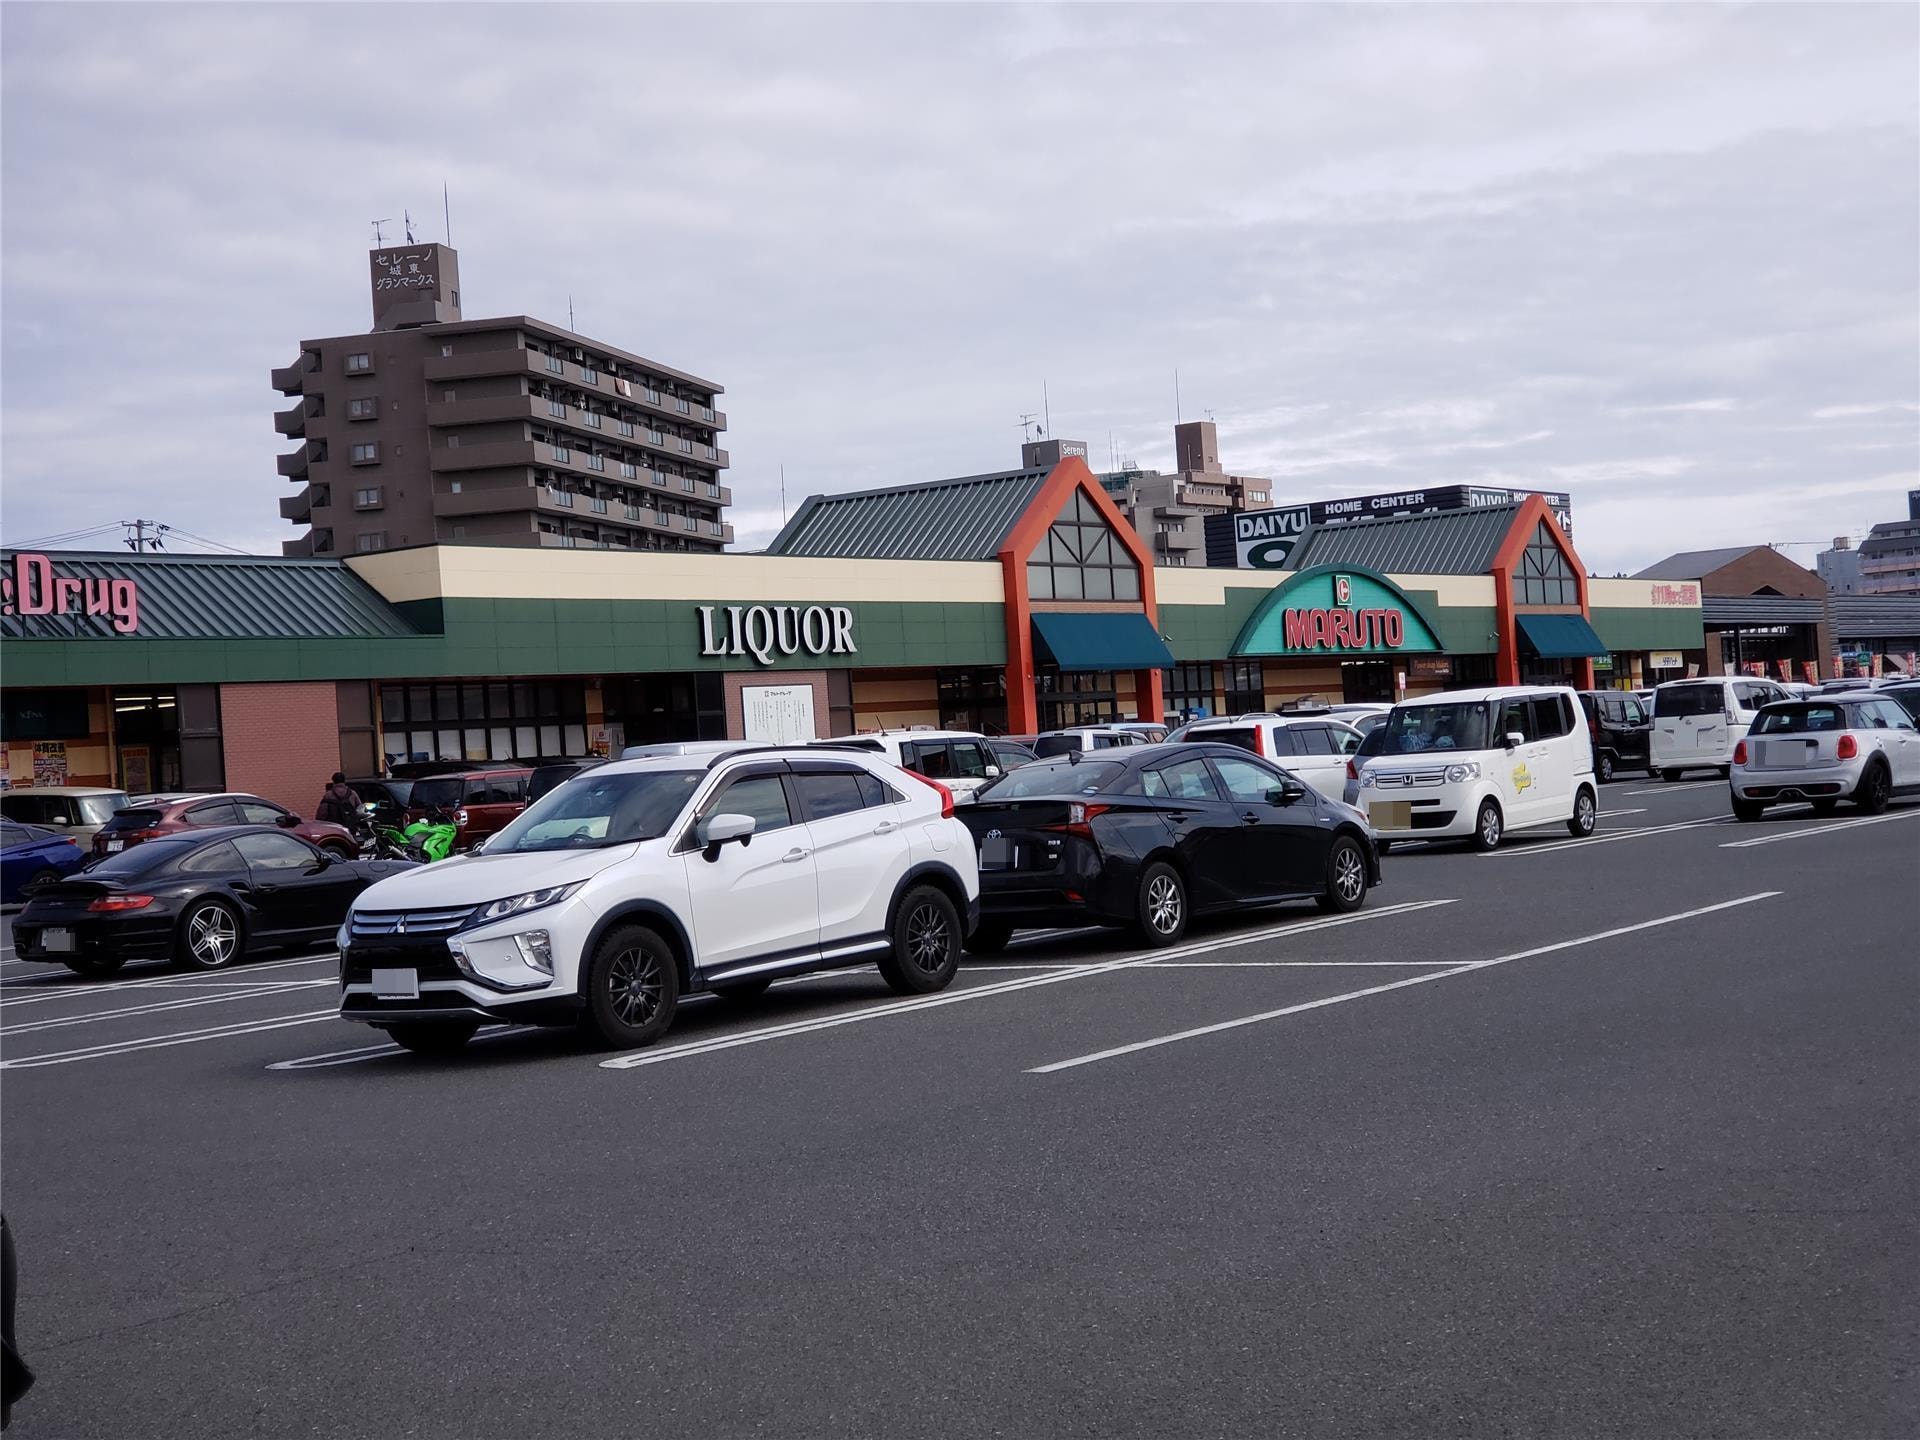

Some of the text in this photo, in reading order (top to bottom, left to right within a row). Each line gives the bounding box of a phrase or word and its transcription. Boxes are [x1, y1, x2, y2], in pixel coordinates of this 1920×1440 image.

[376, 249, 432, 265] セレーノ
[390, 263, 420, 275] 城東
[377, 274, 434, 290] グランマークス
[1062, 443, 1085, 456] Sereno
[1325, 493, 1425, 515] HOME CENTER
[1239, 512, 1307, 539] DAIYU
[699, 605, 858, 665] LIQUOR
[1285, 607, 1405, 649] MARUTO
